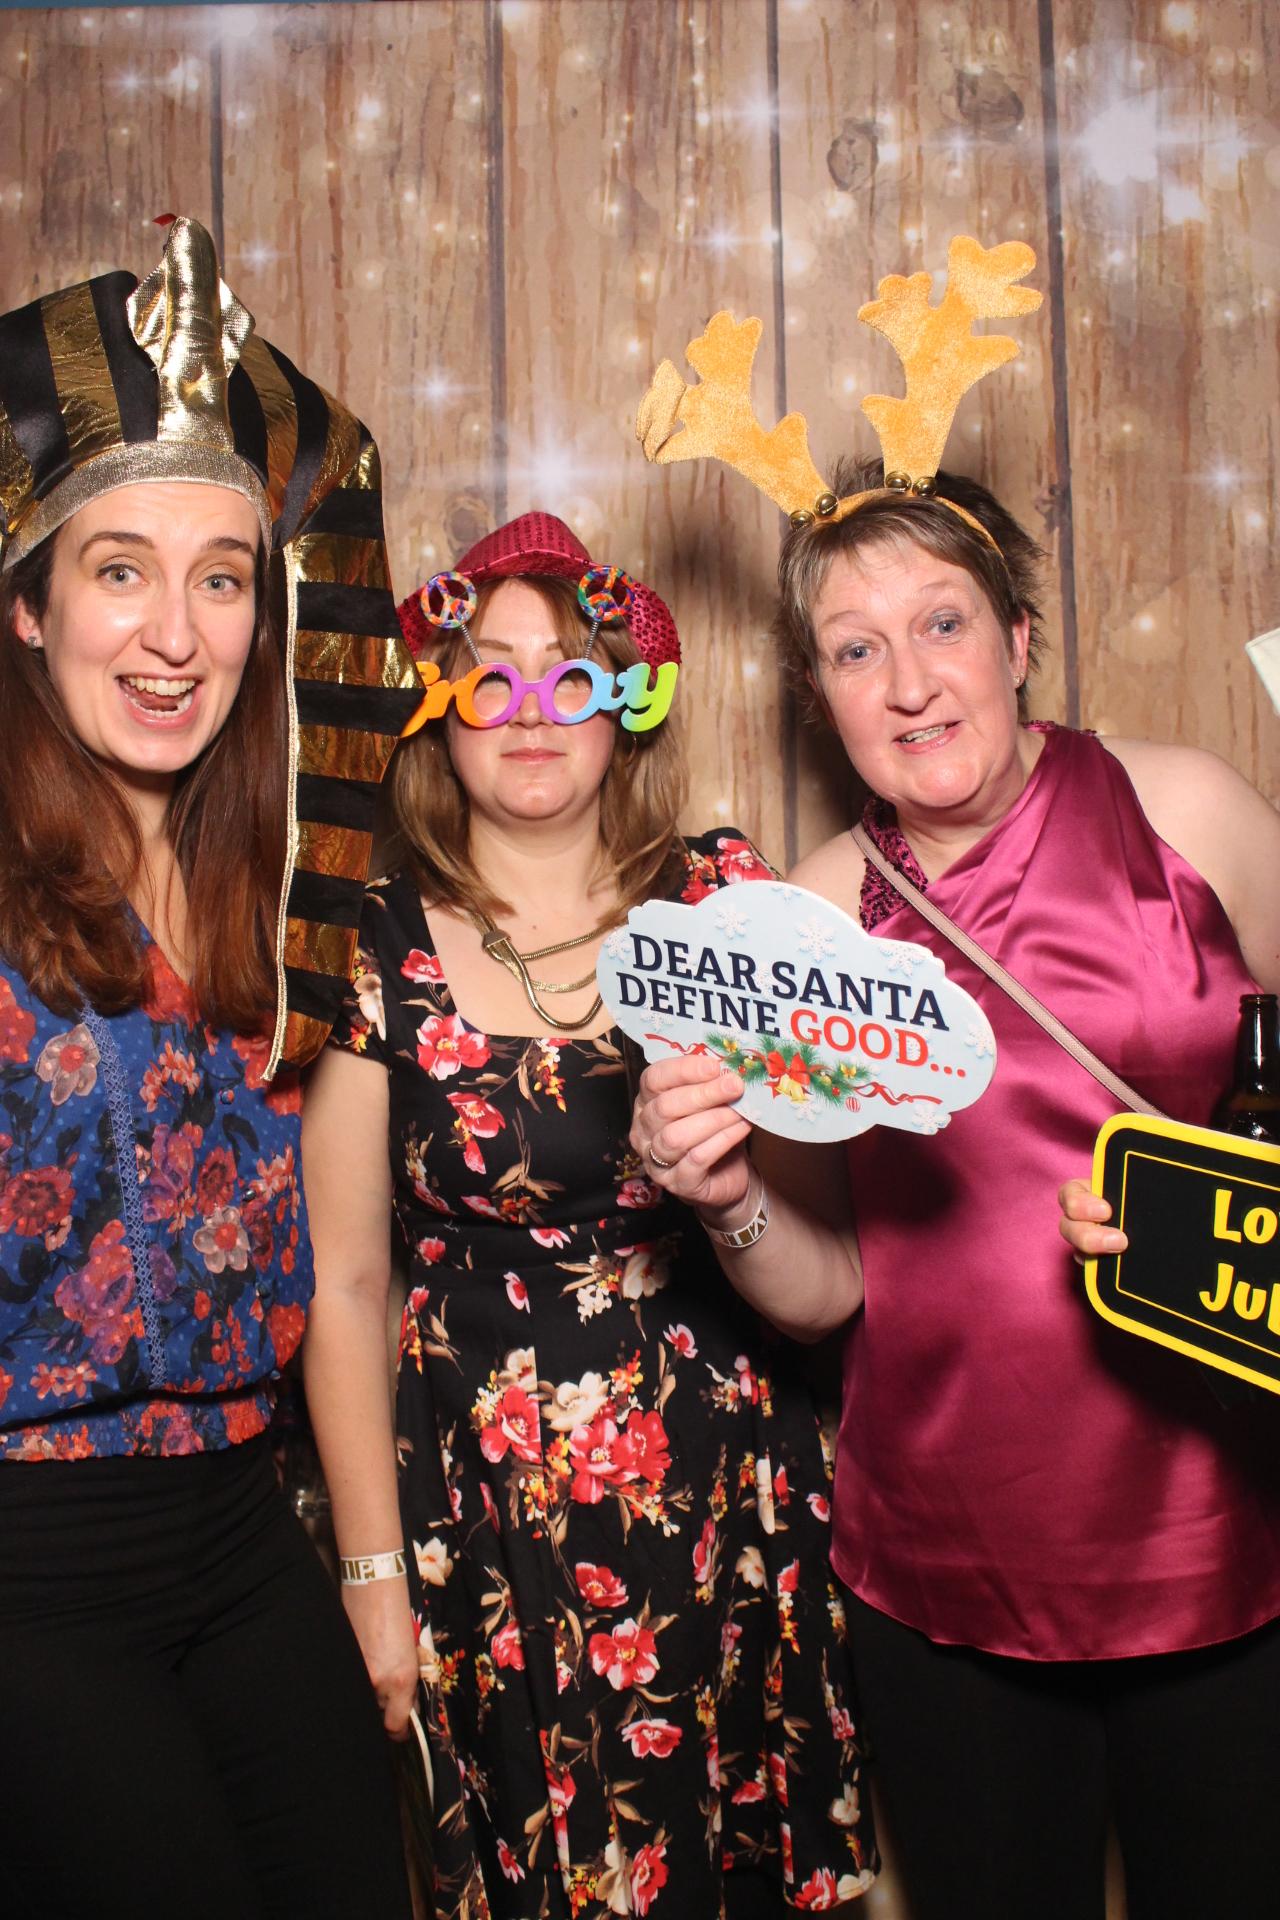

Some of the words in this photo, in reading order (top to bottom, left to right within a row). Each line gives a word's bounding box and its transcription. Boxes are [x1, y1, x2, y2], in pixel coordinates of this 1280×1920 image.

[616, 971, 781, 1038] DEFINE
[790, 1009, 966, 1078] GOOD...
[629, 933, 761, 994] DEAR
[771, 961, 950, 1031] SANTA
[1213, 1188, 1280, 1244] Lo
